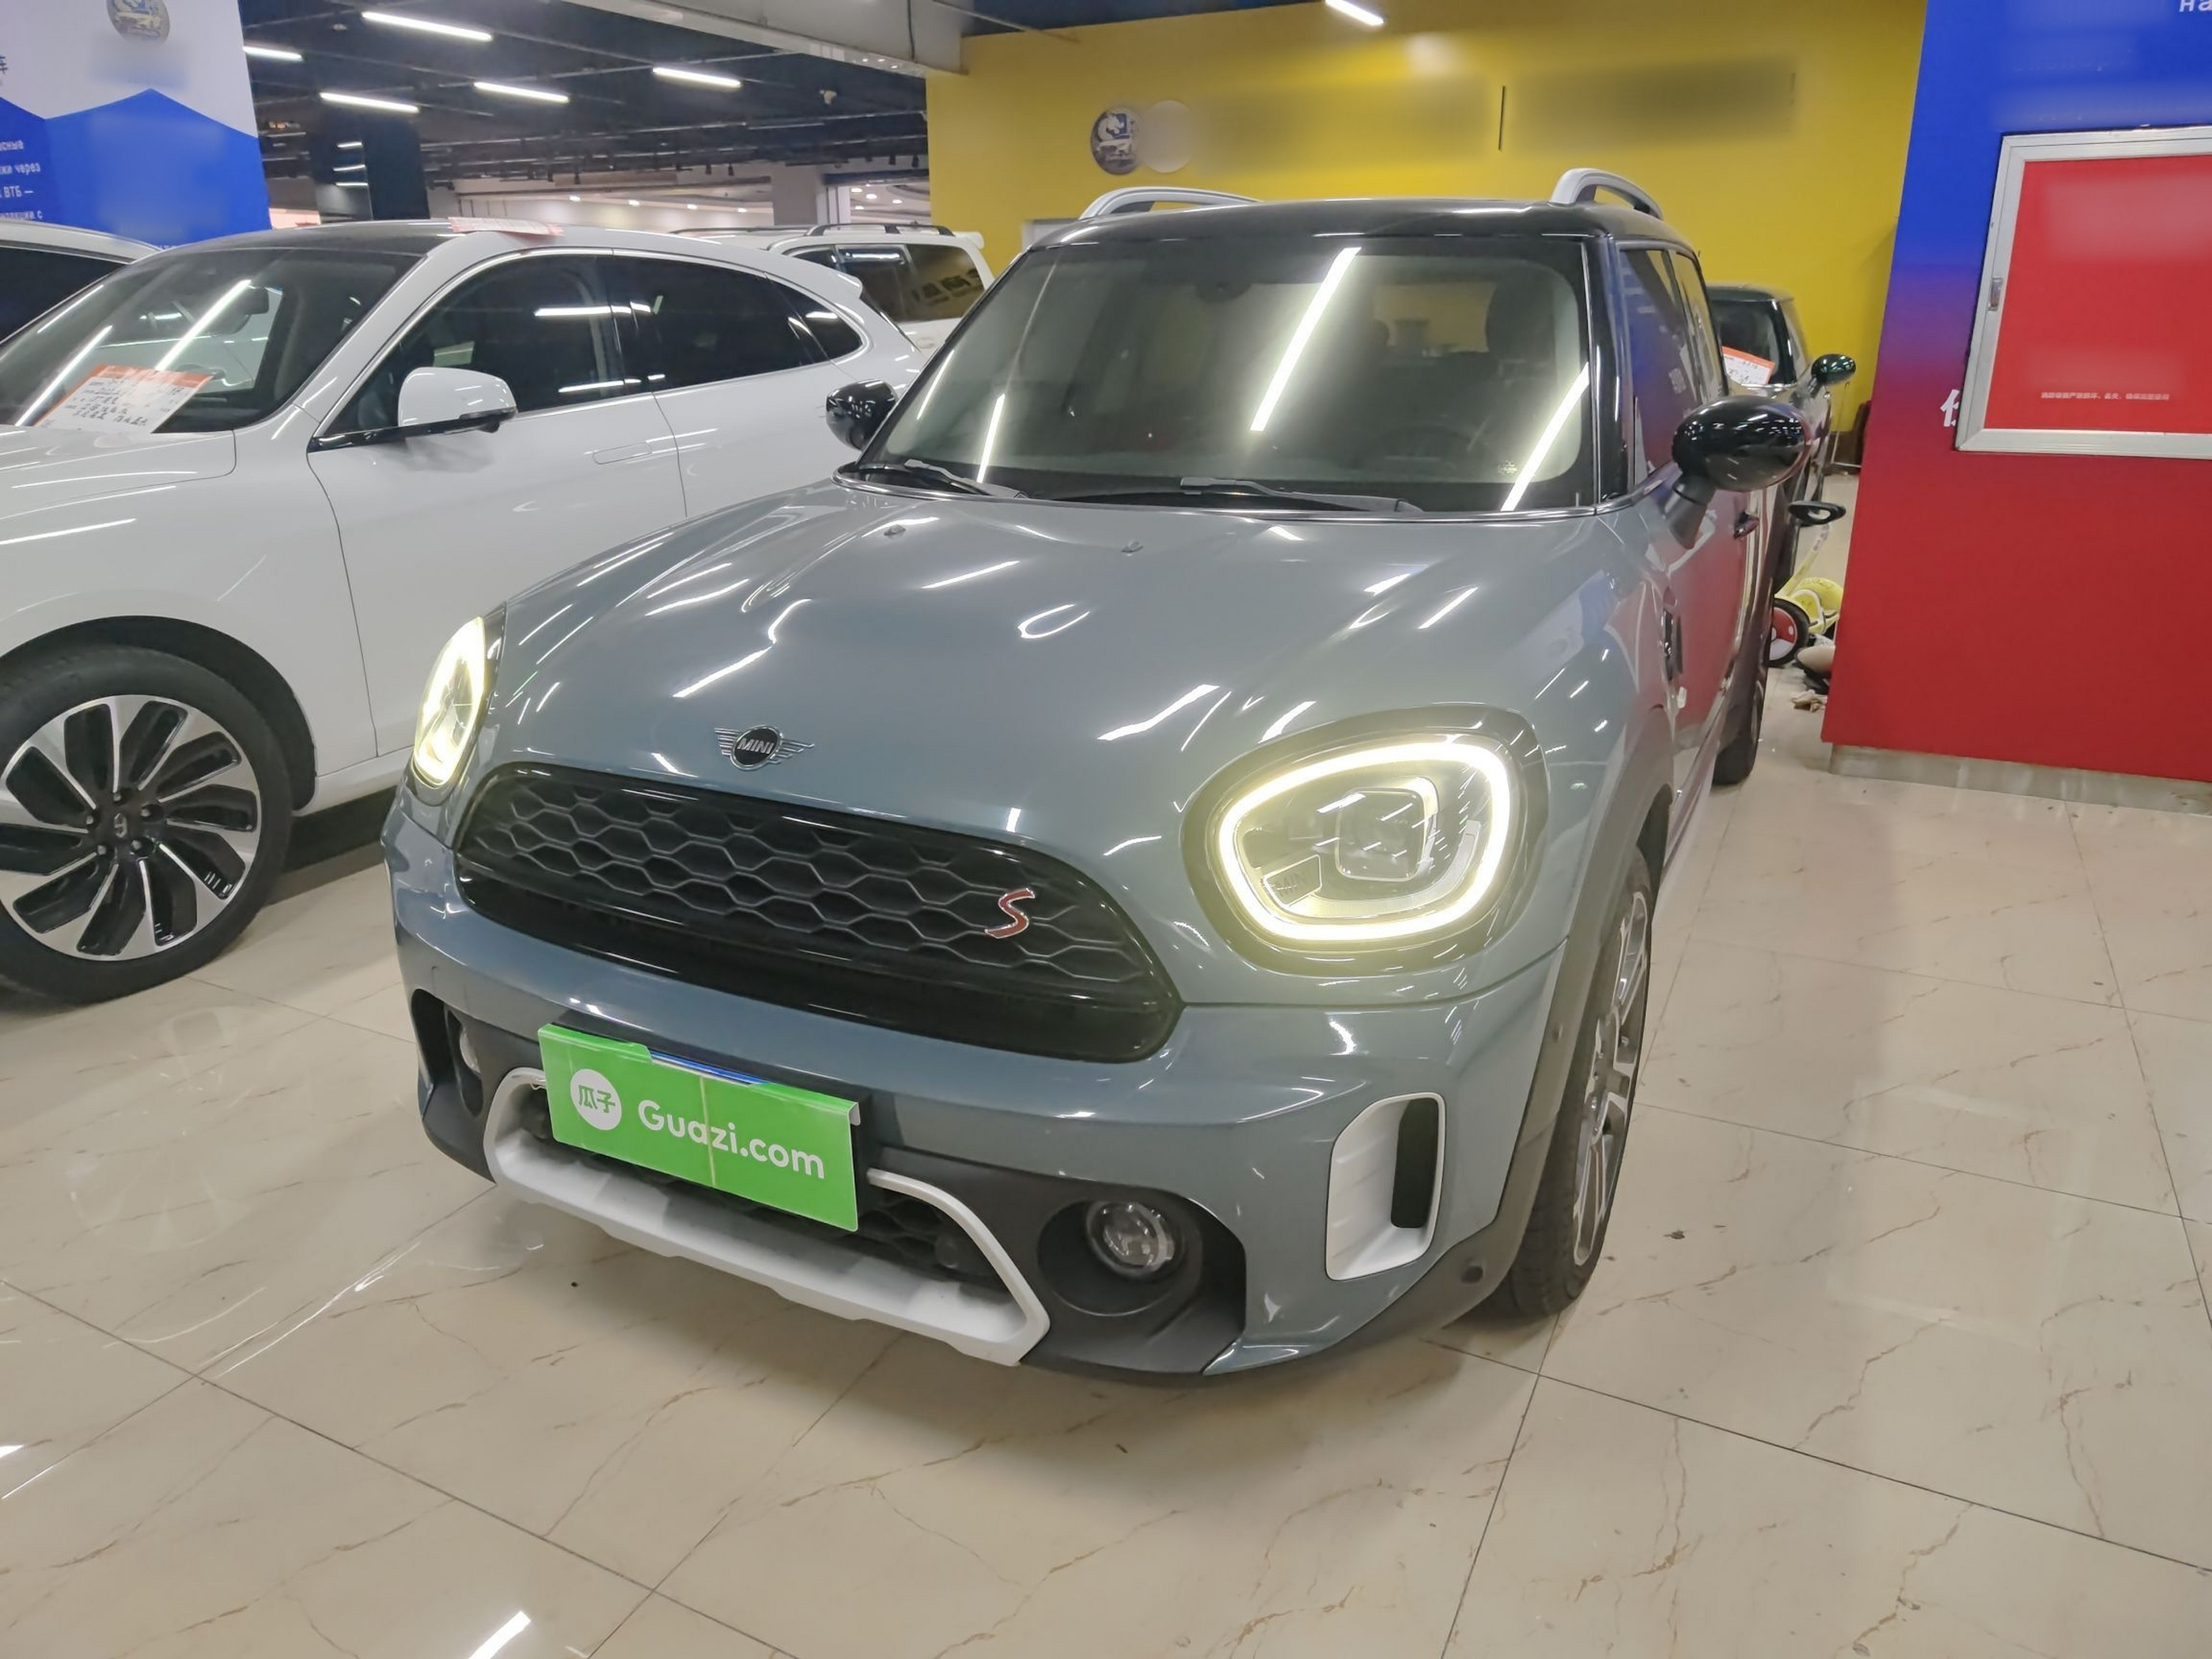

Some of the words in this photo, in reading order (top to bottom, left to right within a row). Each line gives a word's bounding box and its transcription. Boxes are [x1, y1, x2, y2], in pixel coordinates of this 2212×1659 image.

[3, 185, 22, 198] ВТБ
[737, 738, 774, 754] MINI
[984, 888, 1035, 938] S
[578, 1085, 615, 1113] 瓜子
[638, 1100, 824, 1179] Guazi.com
